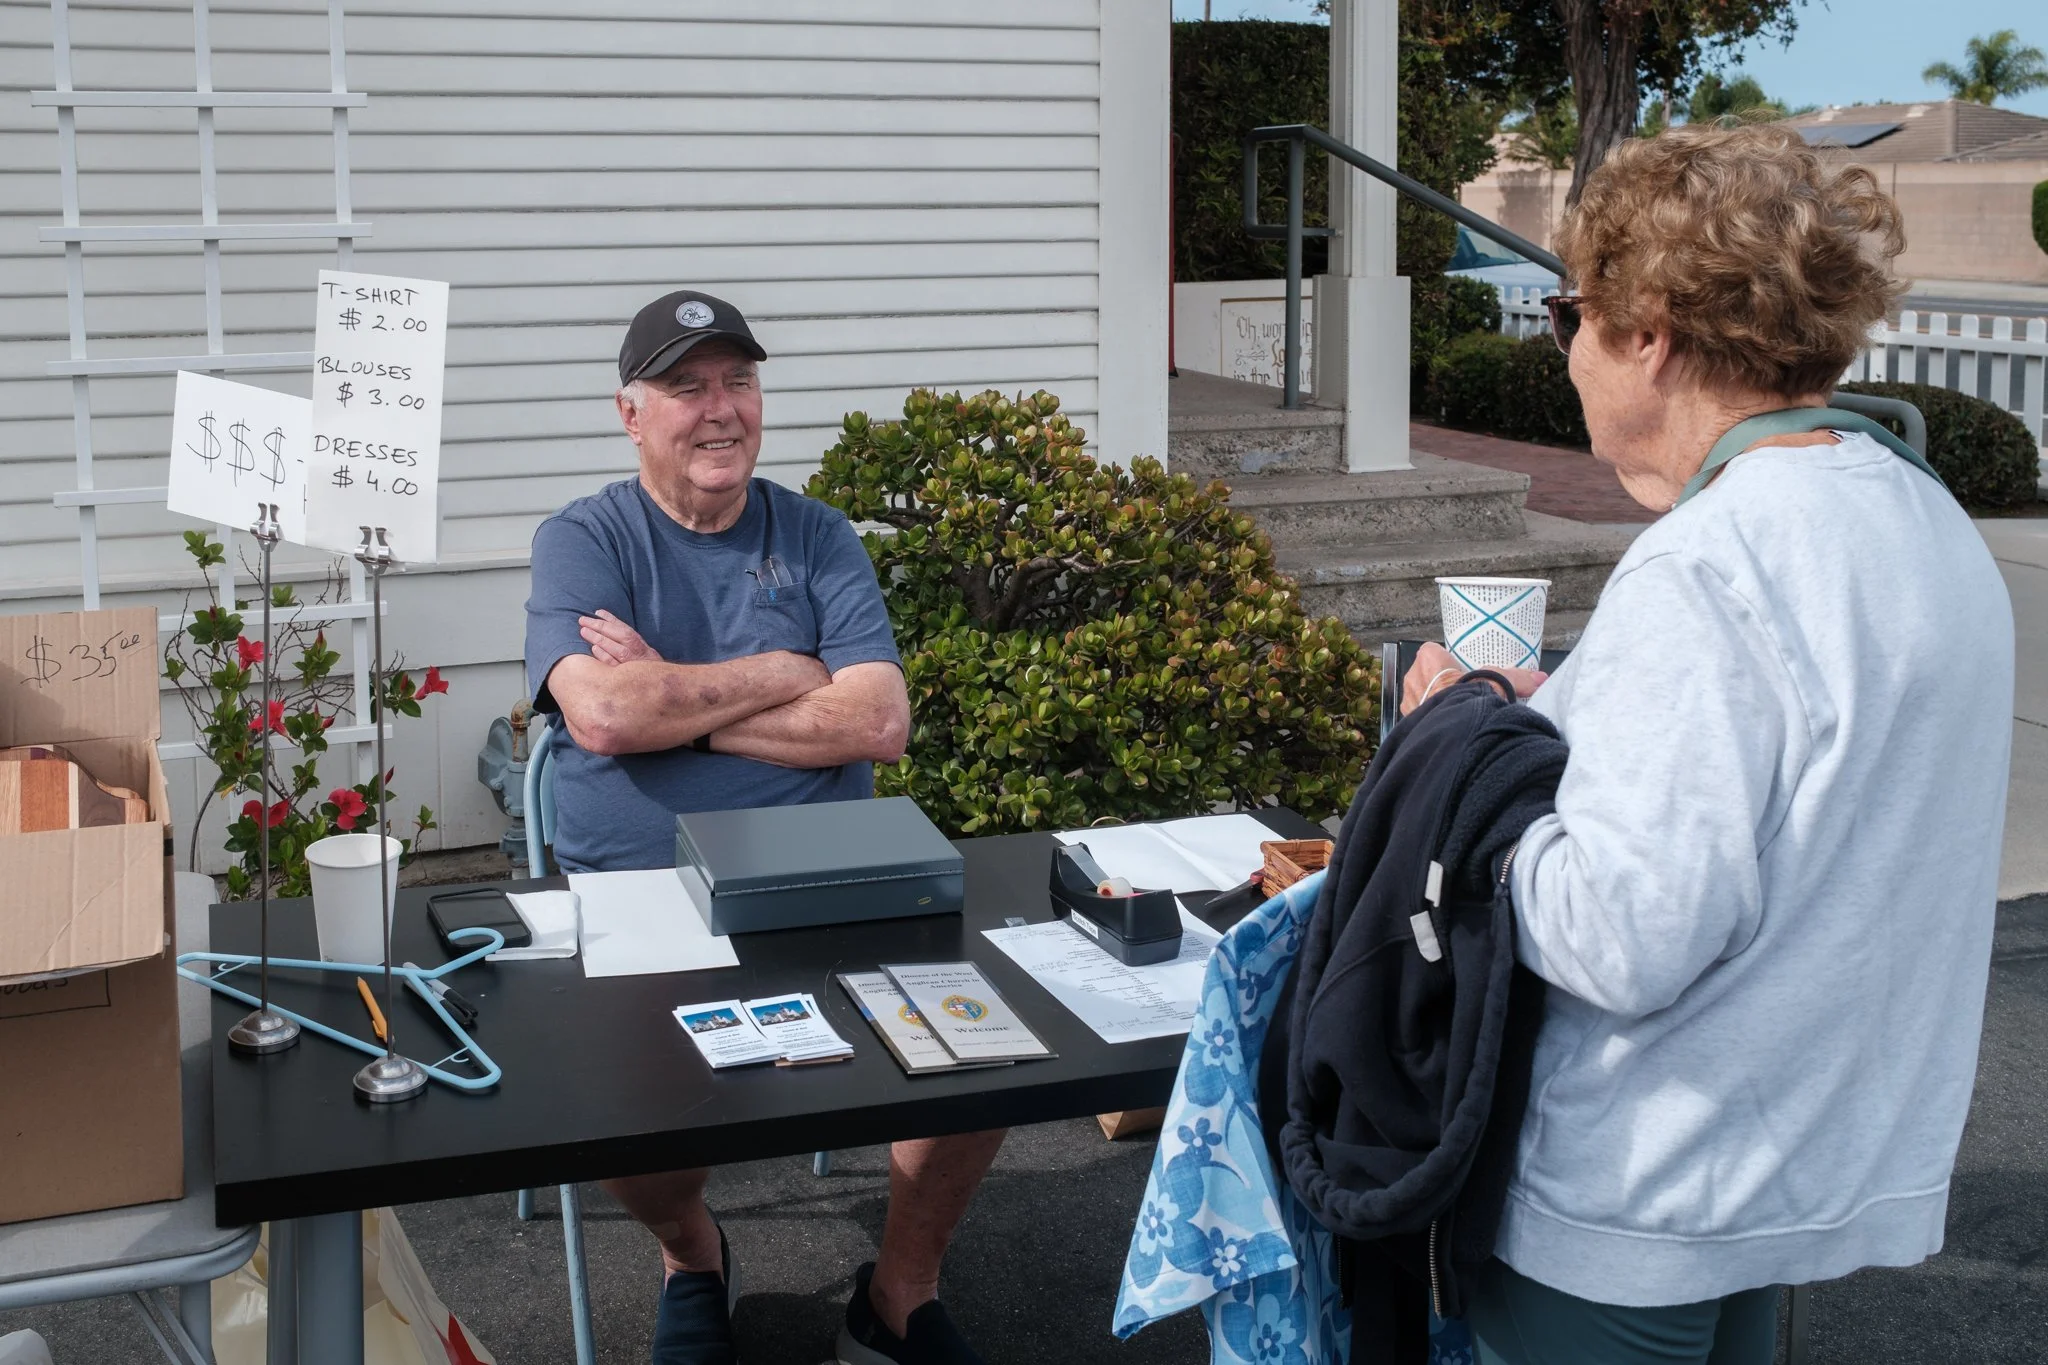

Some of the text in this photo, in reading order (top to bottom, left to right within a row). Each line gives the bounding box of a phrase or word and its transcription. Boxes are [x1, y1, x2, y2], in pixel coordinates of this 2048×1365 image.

[321, 281, 420, 306] T-SHIRT
[1263, 319, 1312, 343] worip
[317, 356, 412, 381] BLOUSES
[314, 434, 418, 467] DRESSES
[954, 1025, 1011, 1035] Welcome
